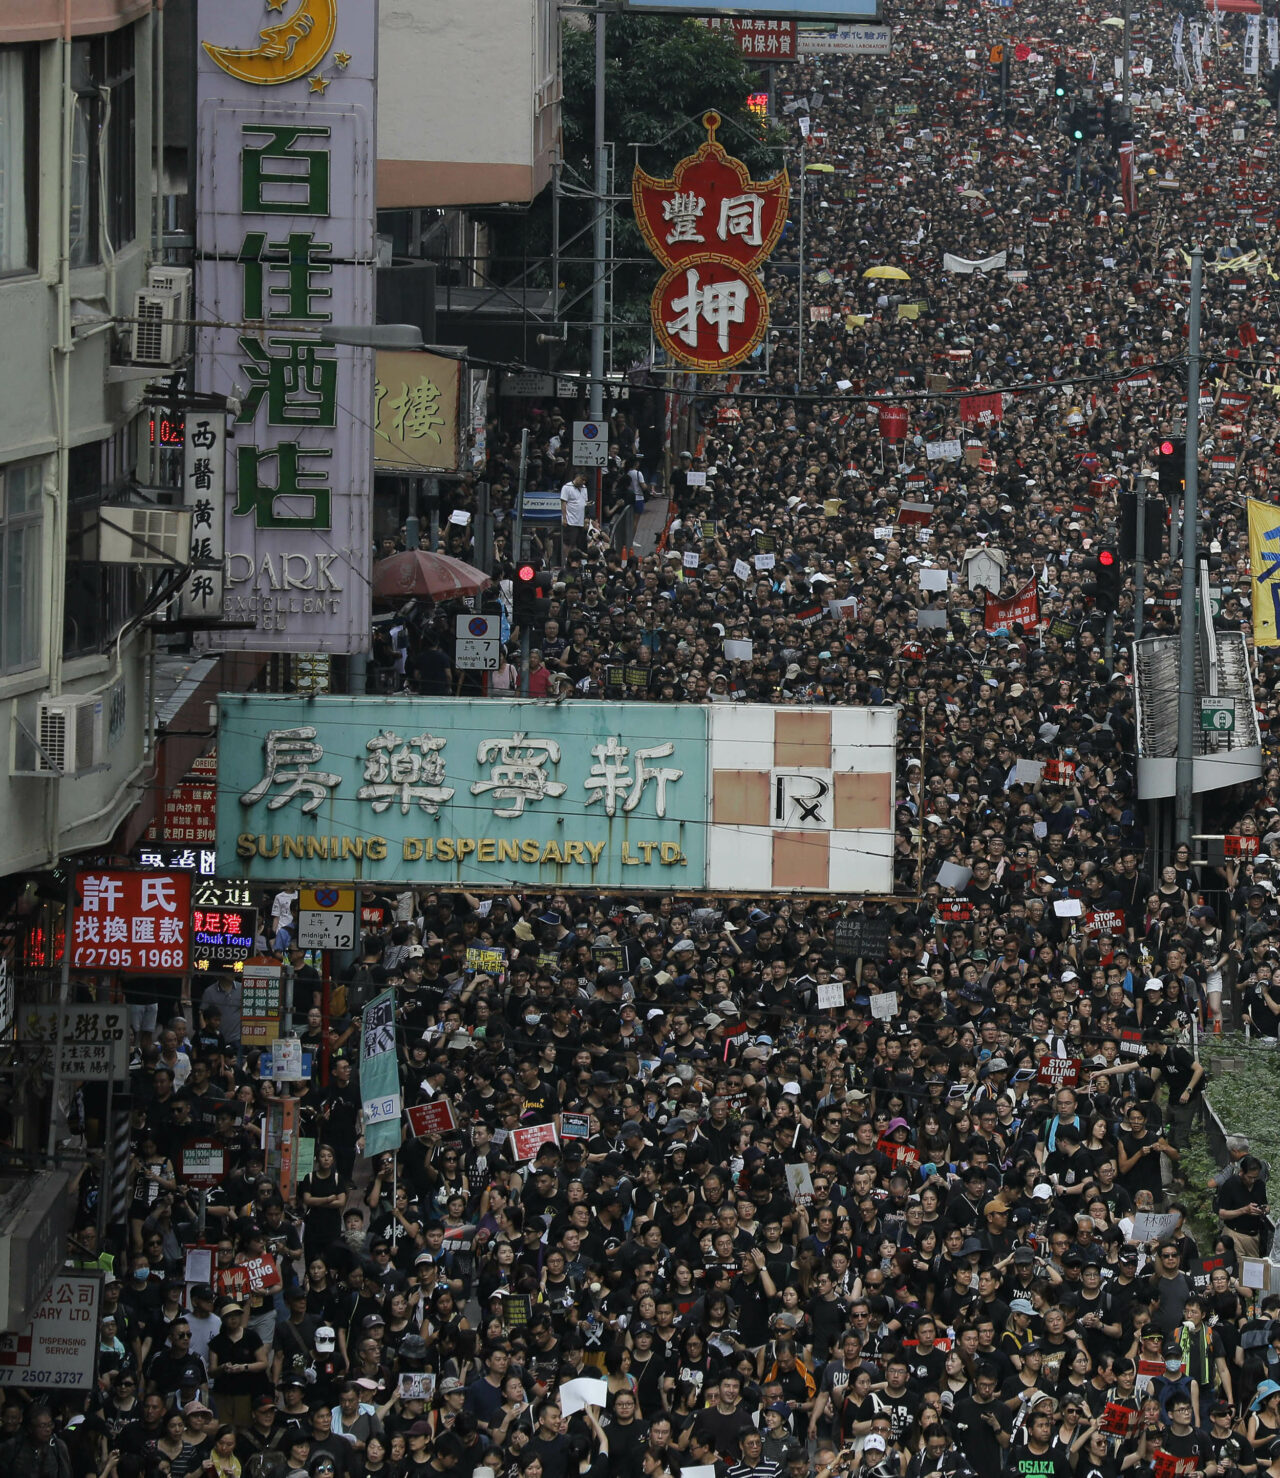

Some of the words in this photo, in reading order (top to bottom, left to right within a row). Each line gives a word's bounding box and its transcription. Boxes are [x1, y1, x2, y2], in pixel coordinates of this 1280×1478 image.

[666, 268, 750, 353] 押
[233, 124, 338, 531] 百佳酒店
[595, 443, 601, 452] 7
[594, 456, 606, 465] 12
[188, 420, 216, 609] 西醫黃振邦
[224, 552, 343, 592] PARK
[223, 597, 341, 615] EXCELLENT
[484, 642, 491, 651] 7
[483, 658, 497, 668] 12
[237, 834, 387, 862] SUNNING
[402, 836, 607, 865] DISPENSARY
[620, 840, 687, 868] LTD.
[82, 875, 177, 912] 許氏
[333, 915, 343, 927] 7
[1094, 911, 1115, 922] STOP
[75, 916, 184, 944] 找換匯款
[1089, 919, 1122, 931] KILLING
[196, 933, 224, 945] Chuk
[226, 934, 252, 947] Tong
[334, 935, 350, 947] 12
[86, 948, 132, 966] 2795
[139, 949, 184, 967] 1968
[268, 980, 279, 988] 914
[1048, 1058, 1073, 1069] STOP
[1042, 1066, 1076, 1078] KILLING
[69, 1308, 92, 1322] LTD.
[39, 1337, 87, 1347] DISPENSING
[45, 1346, 79, 1356] SERVICE
[22, 1370, 52, 1382] 2507
[54, 1372, 84, 1384] 3737
[1018, 1460, 1055, 1475] OSAKA
